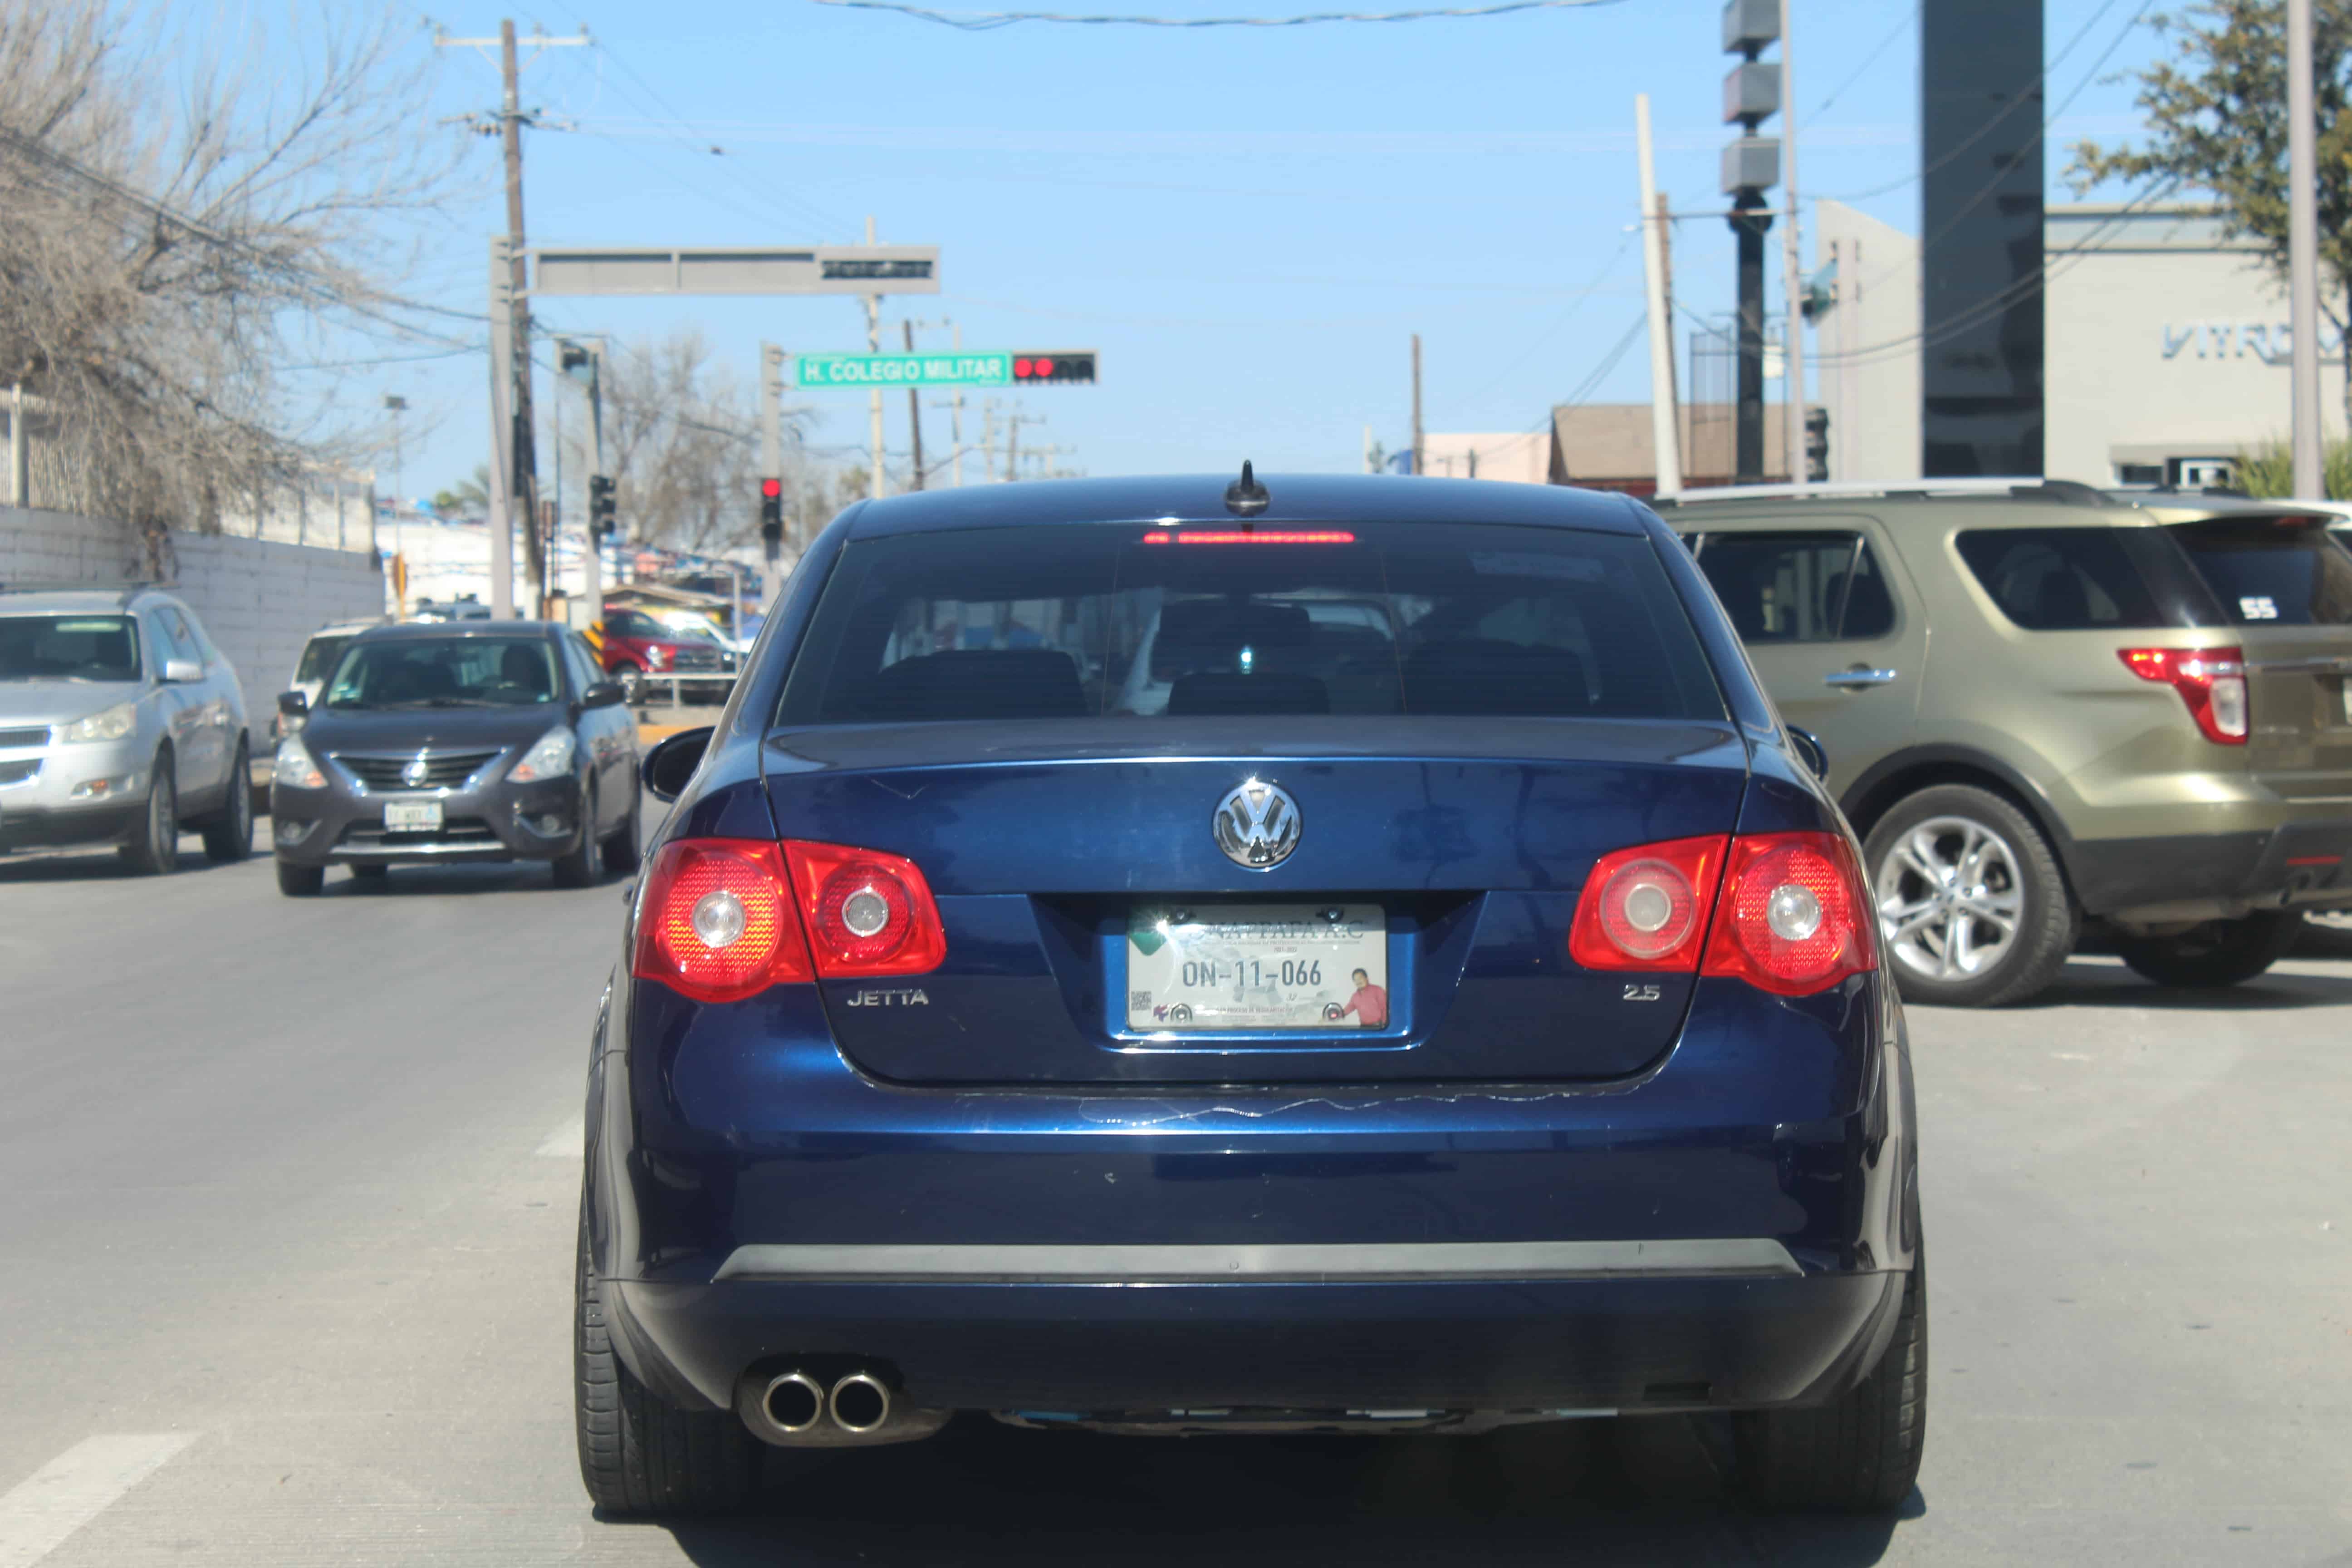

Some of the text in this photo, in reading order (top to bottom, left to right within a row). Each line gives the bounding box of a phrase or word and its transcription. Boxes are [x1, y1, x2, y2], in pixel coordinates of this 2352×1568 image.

[805, 358, 1002, 381] H. COLEGIO MILITAR
[847, 989, 929, 1007] JETTA
